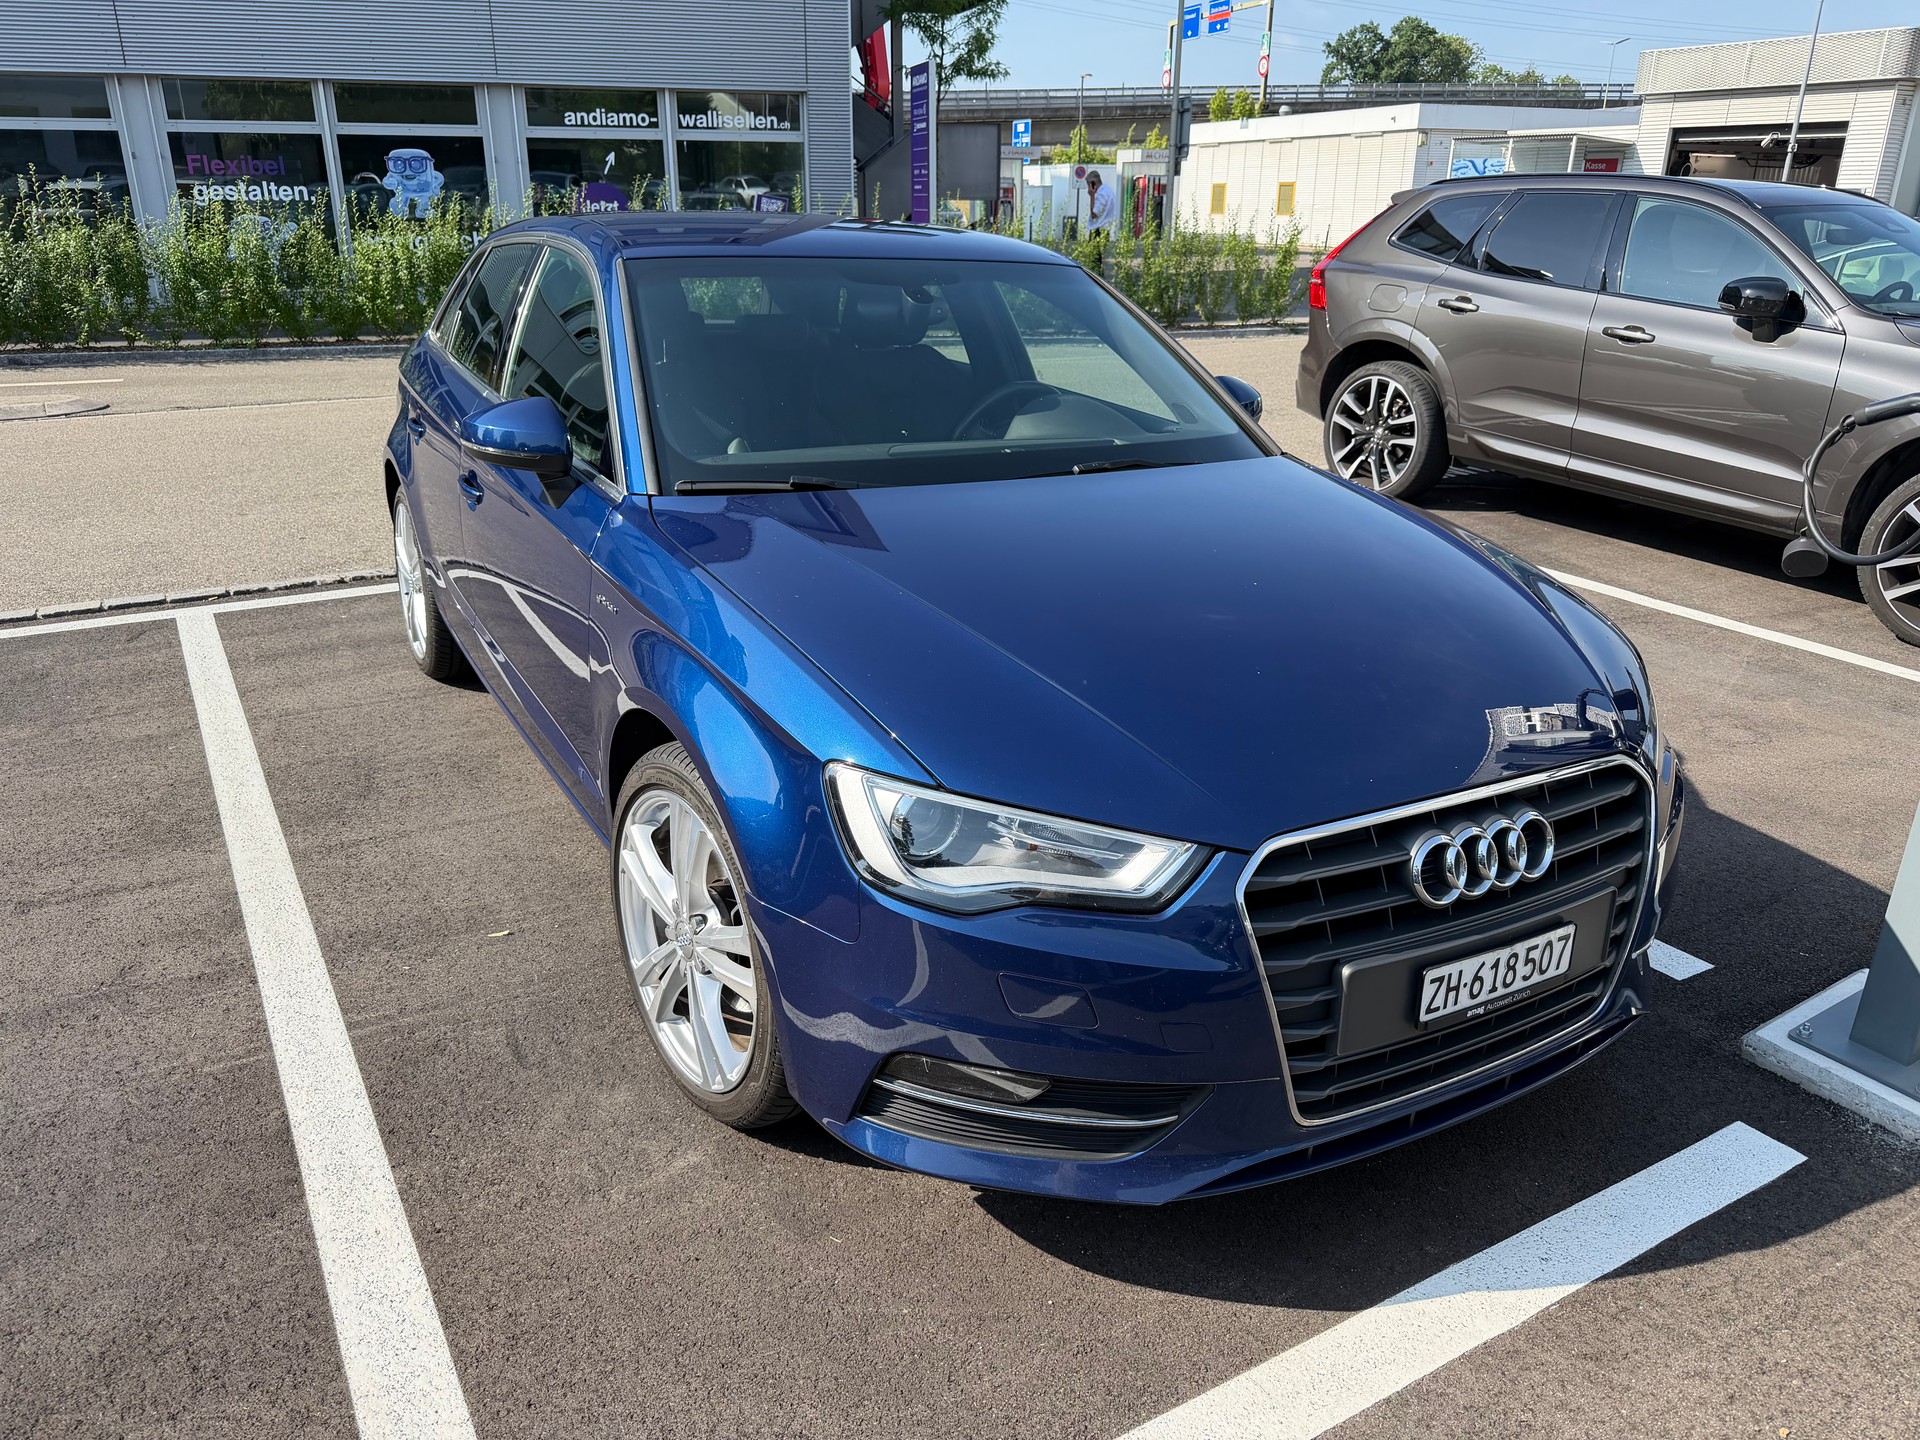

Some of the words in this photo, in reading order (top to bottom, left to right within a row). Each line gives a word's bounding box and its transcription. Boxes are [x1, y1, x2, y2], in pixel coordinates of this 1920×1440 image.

[563, 108, 658, 127] andiamo-
[186, 154, 286, 176] Flexibel
[1585, 161, 1606, 170] Kasse
[1466, 1005, 1485, 1017] amag
[1486, 996, 1513, 1010] Autowelt
[1513, 989, 1531, 1002] Zürich
